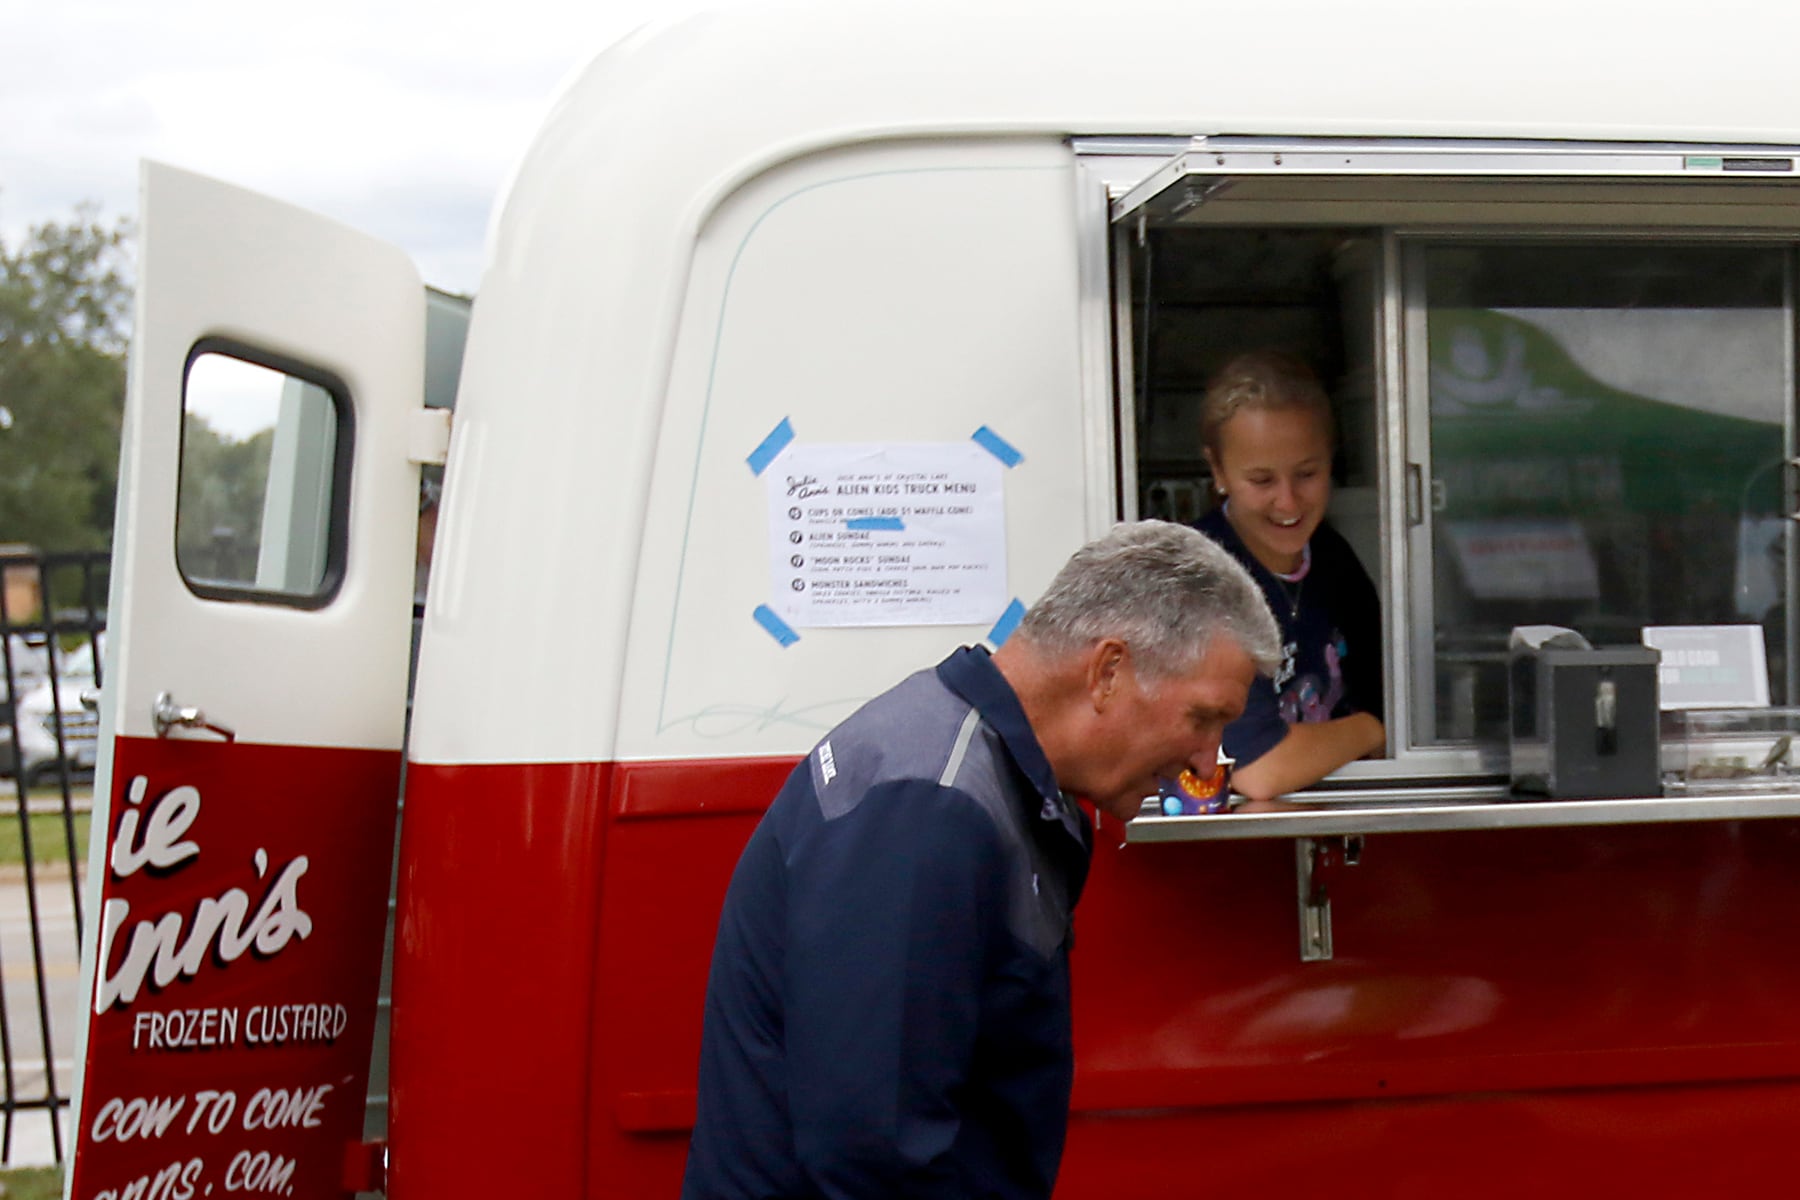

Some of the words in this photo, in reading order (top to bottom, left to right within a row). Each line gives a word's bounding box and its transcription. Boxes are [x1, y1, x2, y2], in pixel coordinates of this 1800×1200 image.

[836, 483, 869, 495] ALIEN
[874, 483, 900, 495] KIDS
[905, 483, 939, 495] TRUCK
[944, 483, 977, 494] MENU
[809, 532, 834, 541] ALIEN
[837, 532, 870, 540] SUNDAE
[878, 555, 911, 564] SUNDAE
[811, 581, 850, 589] MONSTER
[854, 580, 908, 588] SANDWICHES
[133, 1007, 238, 1050] FROZEN
[245, 1003, 348, 1044] CUSTARD
[91, 1094, 185, 1143] COW
[187, 1090, 236, 1135] TO
